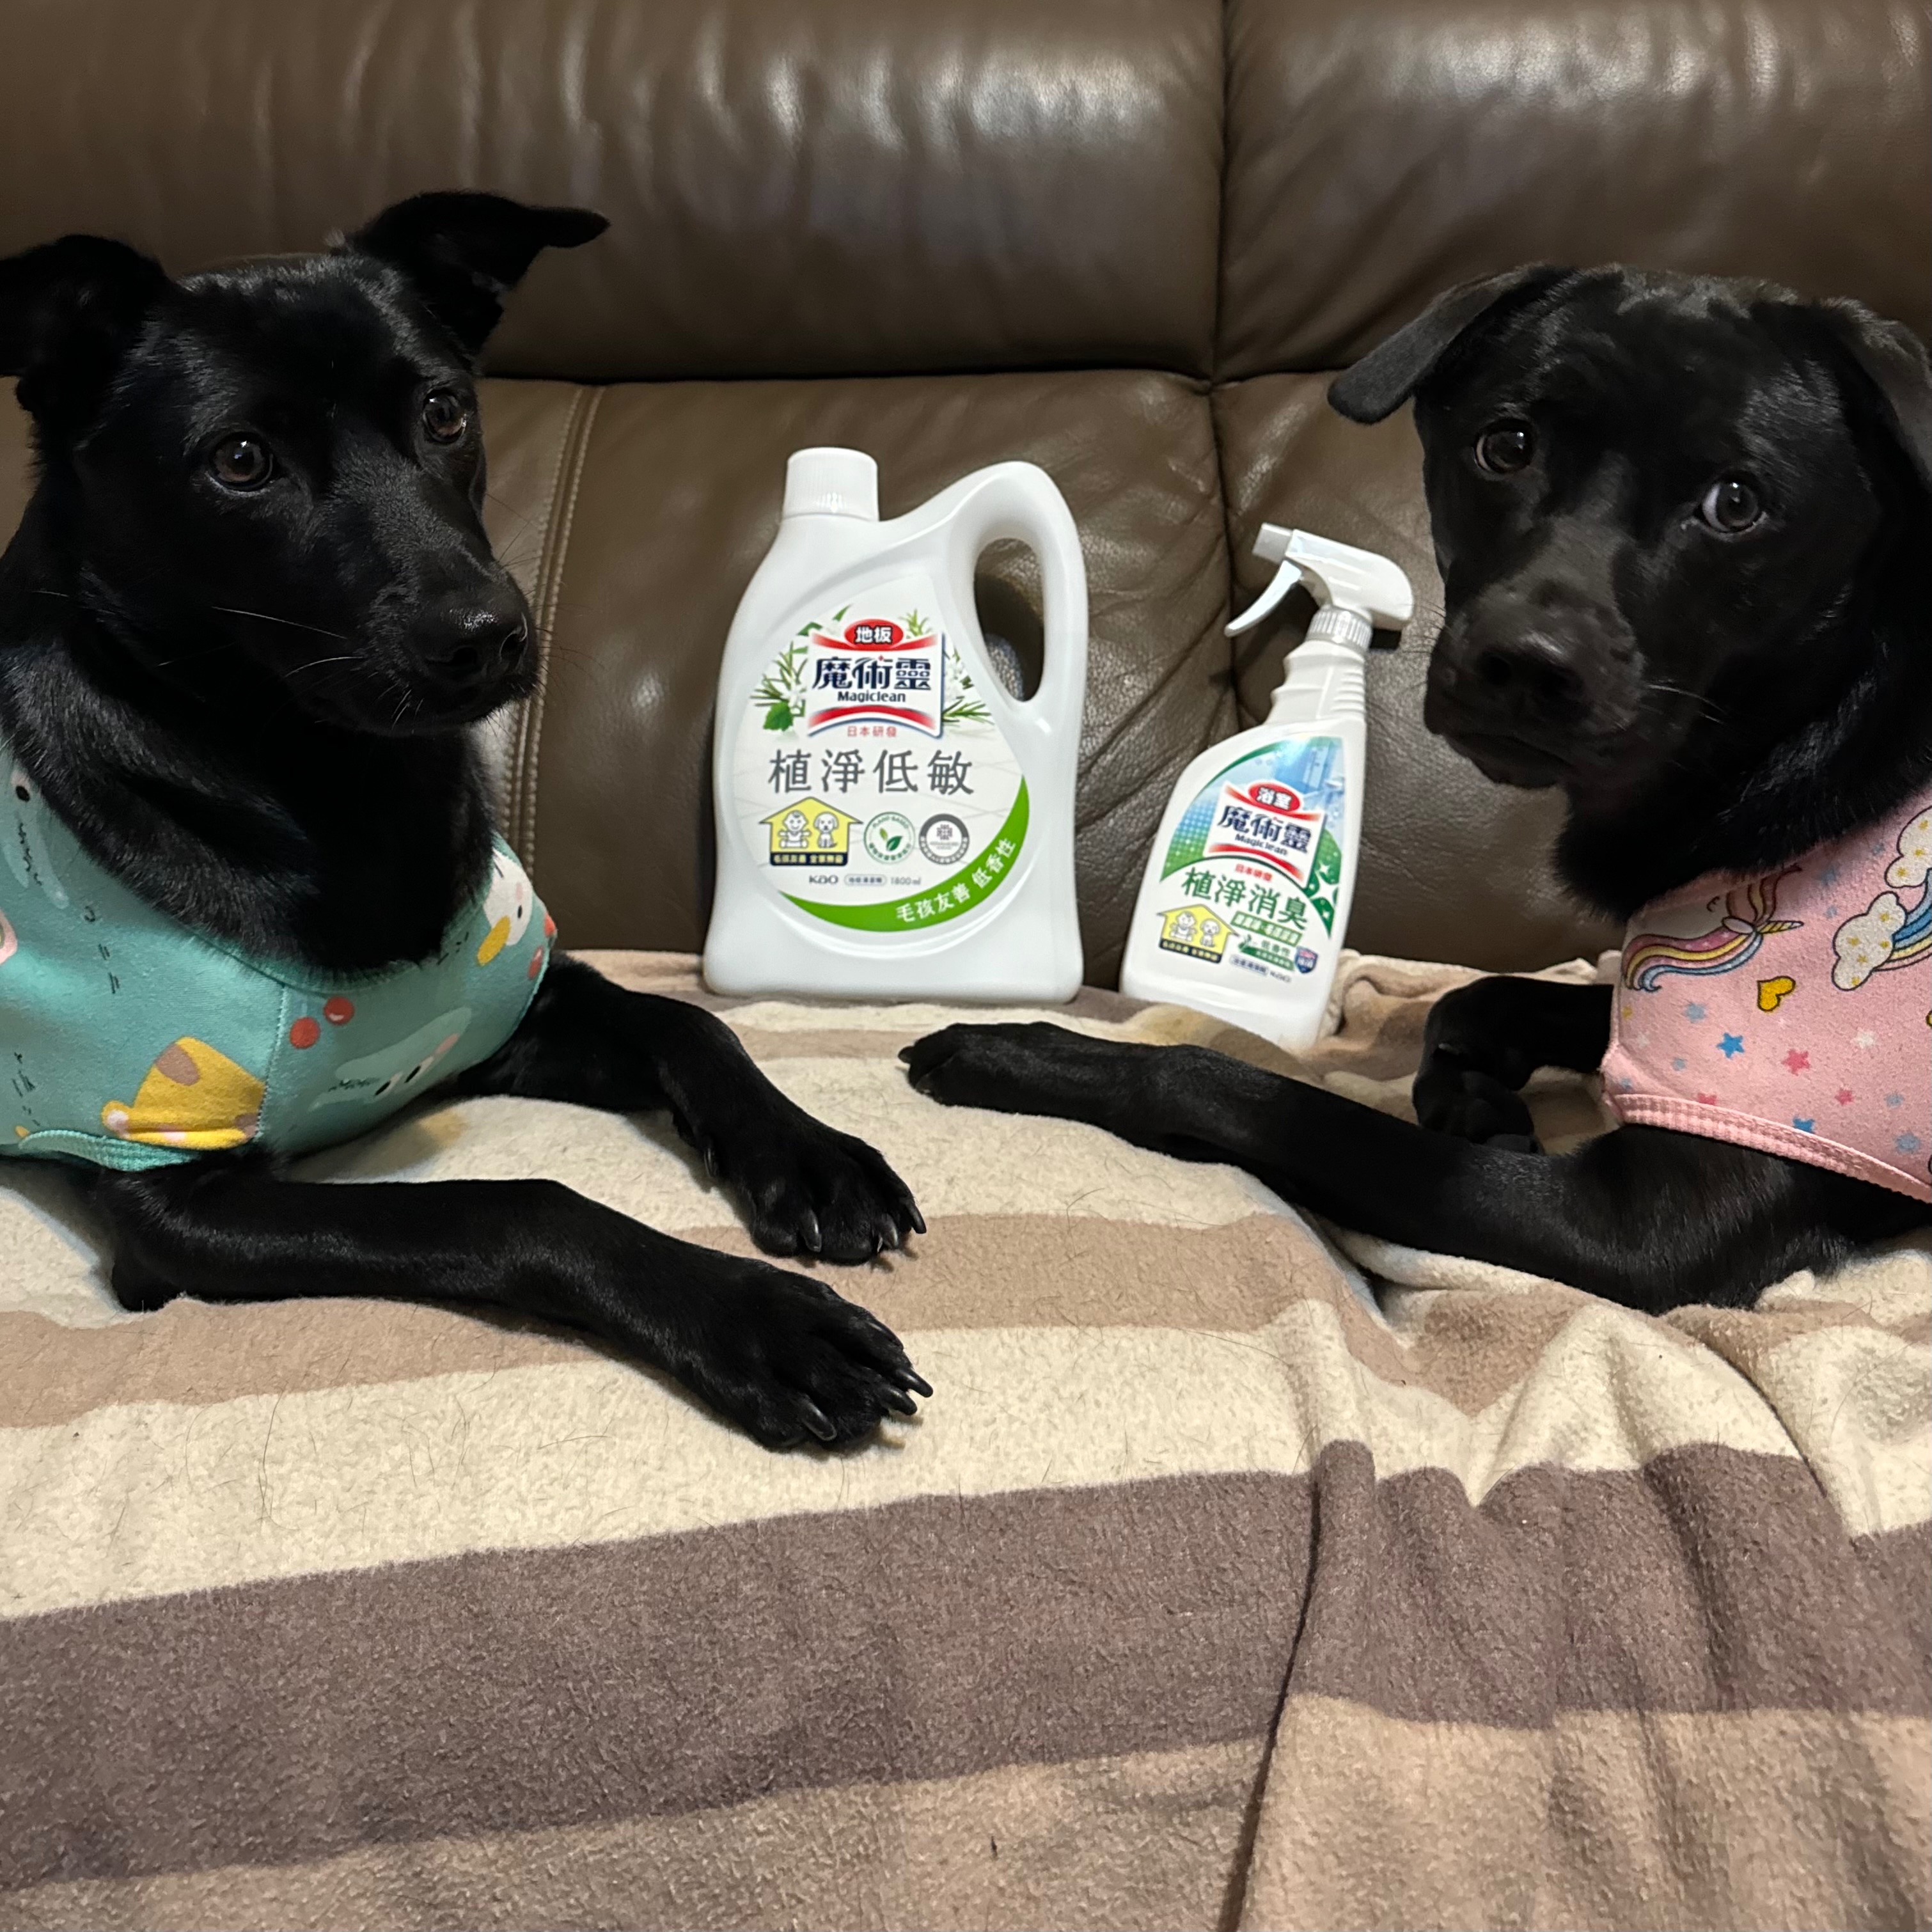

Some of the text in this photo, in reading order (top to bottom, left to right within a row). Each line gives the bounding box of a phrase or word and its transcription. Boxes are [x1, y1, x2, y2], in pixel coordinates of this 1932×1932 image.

[856, 626, 891, 643] 地板
[812, 656, 931, 690] 魔術靈
[837, 691, 906, 702] Magiclean
[847, 726, 897, 737] 日本研發
[767, 749, 974, 795] 植淨低敏
[1217, 806, 1311, 854] 魔術靈
[1235, 833, 1287, 855] Magiclean
[896, 883, 970, 922] 毛孩友善
[971, 838, 1016, 888] 低香性
[1182, 867, 1307, 929] 植淨消臭
